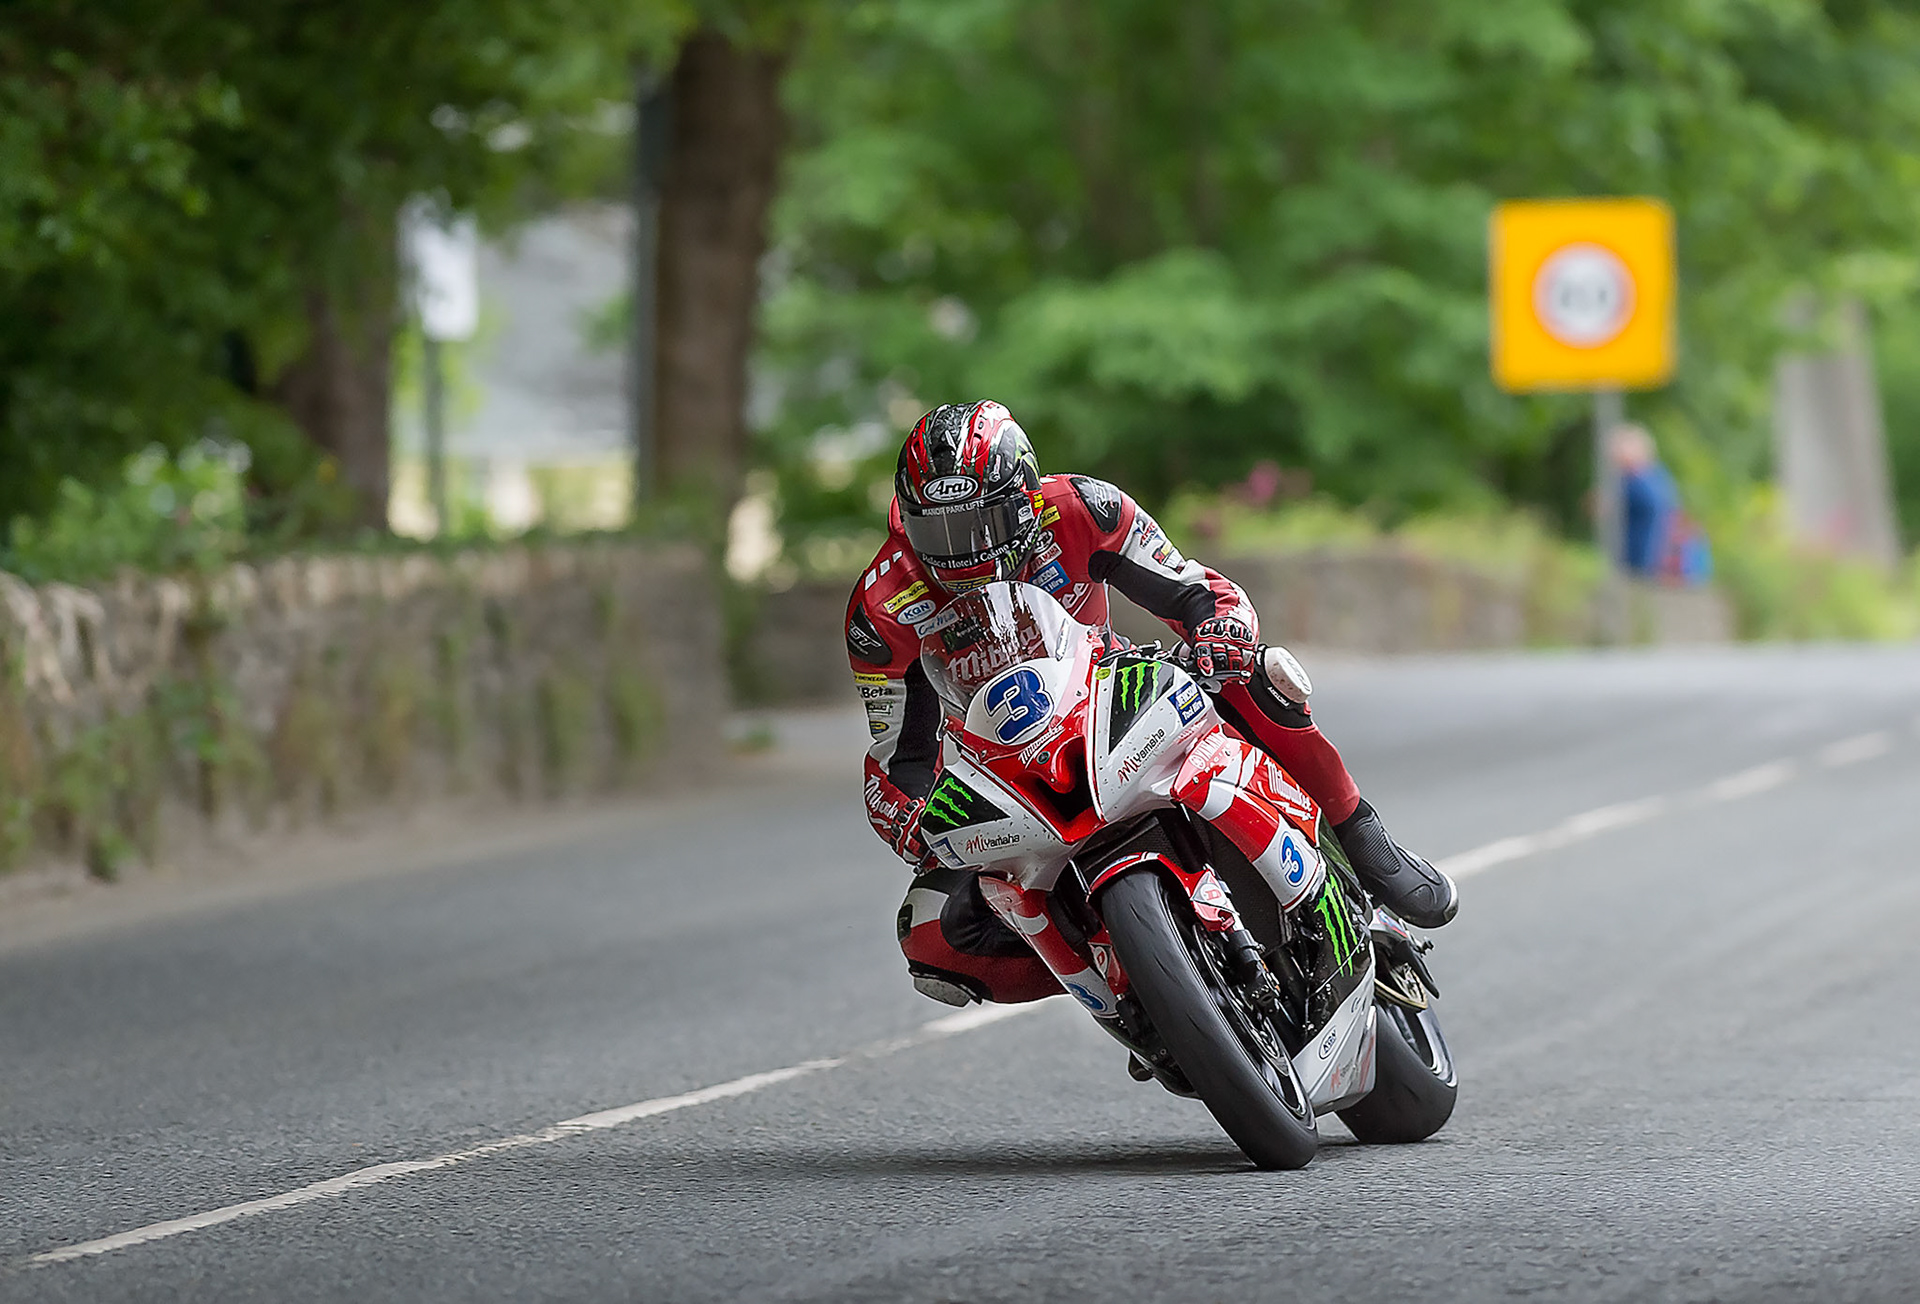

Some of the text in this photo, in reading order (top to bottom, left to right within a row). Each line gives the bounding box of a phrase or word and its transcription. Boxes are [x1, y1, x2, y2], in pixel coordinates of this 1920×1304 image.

[929, 479, 972, 496] Arai
[922, 499, 985, 516] MANOR PARK LIFTS
[948, 559, 972, 569] Hotel
[980, 544, 1010, 562] Casino
[861, 686, 892, 698] Beta
[984, 665, 1055, 744] 3
[1280, 831, 1305, 887] 3
